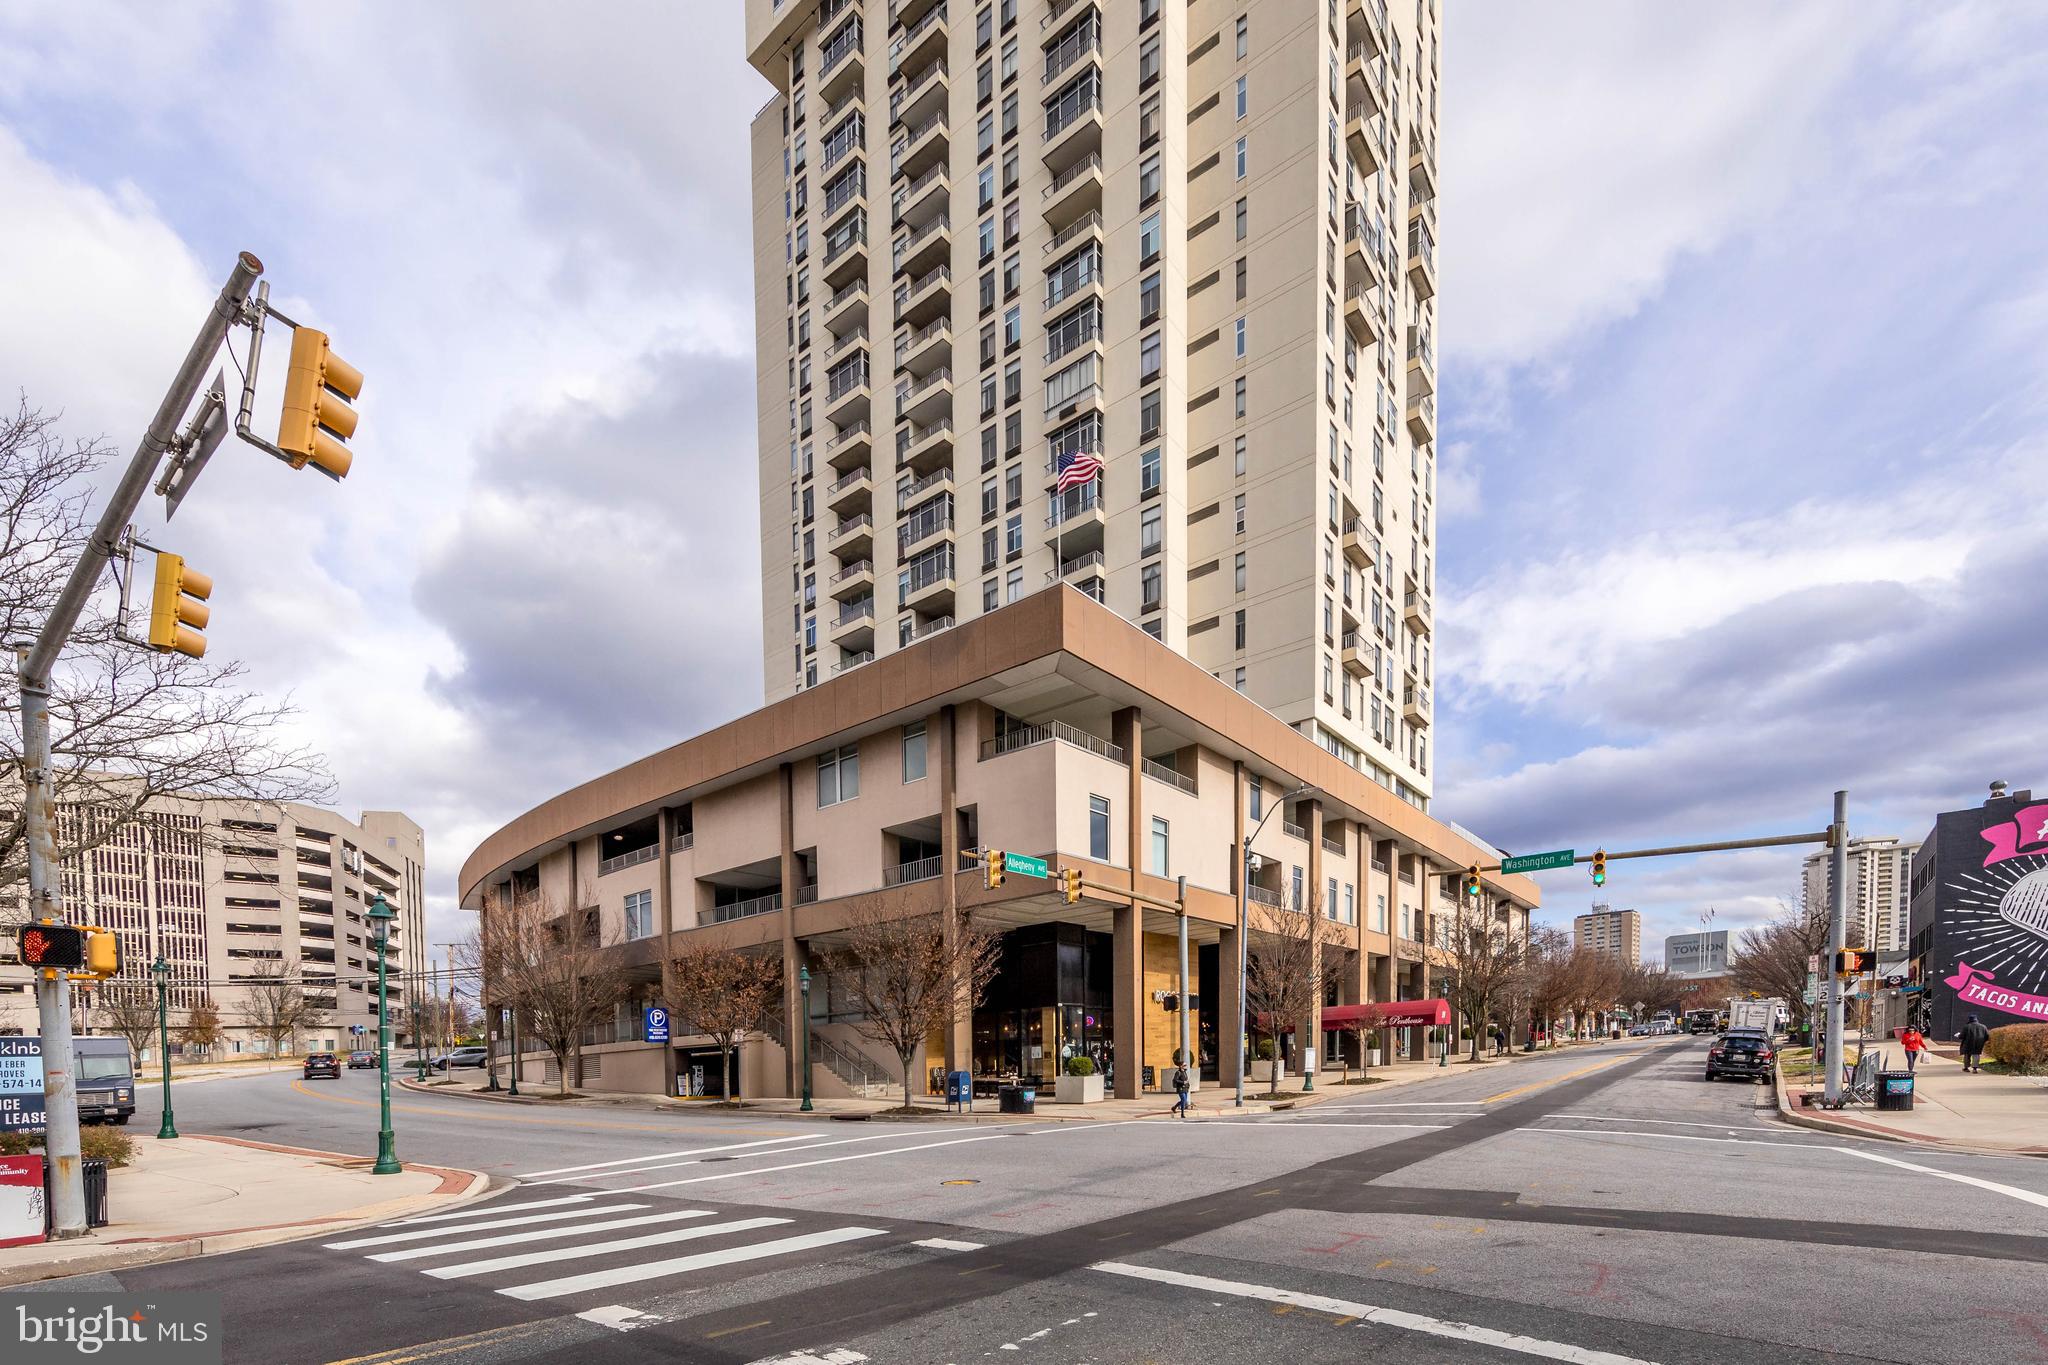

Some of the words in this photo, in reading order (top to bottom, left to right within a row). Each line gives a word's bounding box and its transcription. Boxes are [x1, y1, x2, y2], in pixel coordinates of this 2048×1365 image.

[1009, 857, 1034, 874] Allegheny
[1038, 865, 1046, 873] AVE
[1506, 856, 1555, 869] Washington
[1672, 942, 1724, 954] TOWSON
[1967, 984, 2018, 1008] TACOS
[1389, 1014, 1424, 1025] Penthouse
[1, 1042, 41, 1055] klnb
[5, 1060, 26, 1069] EBER
[5, 1112, 47, 1125] LEASE
